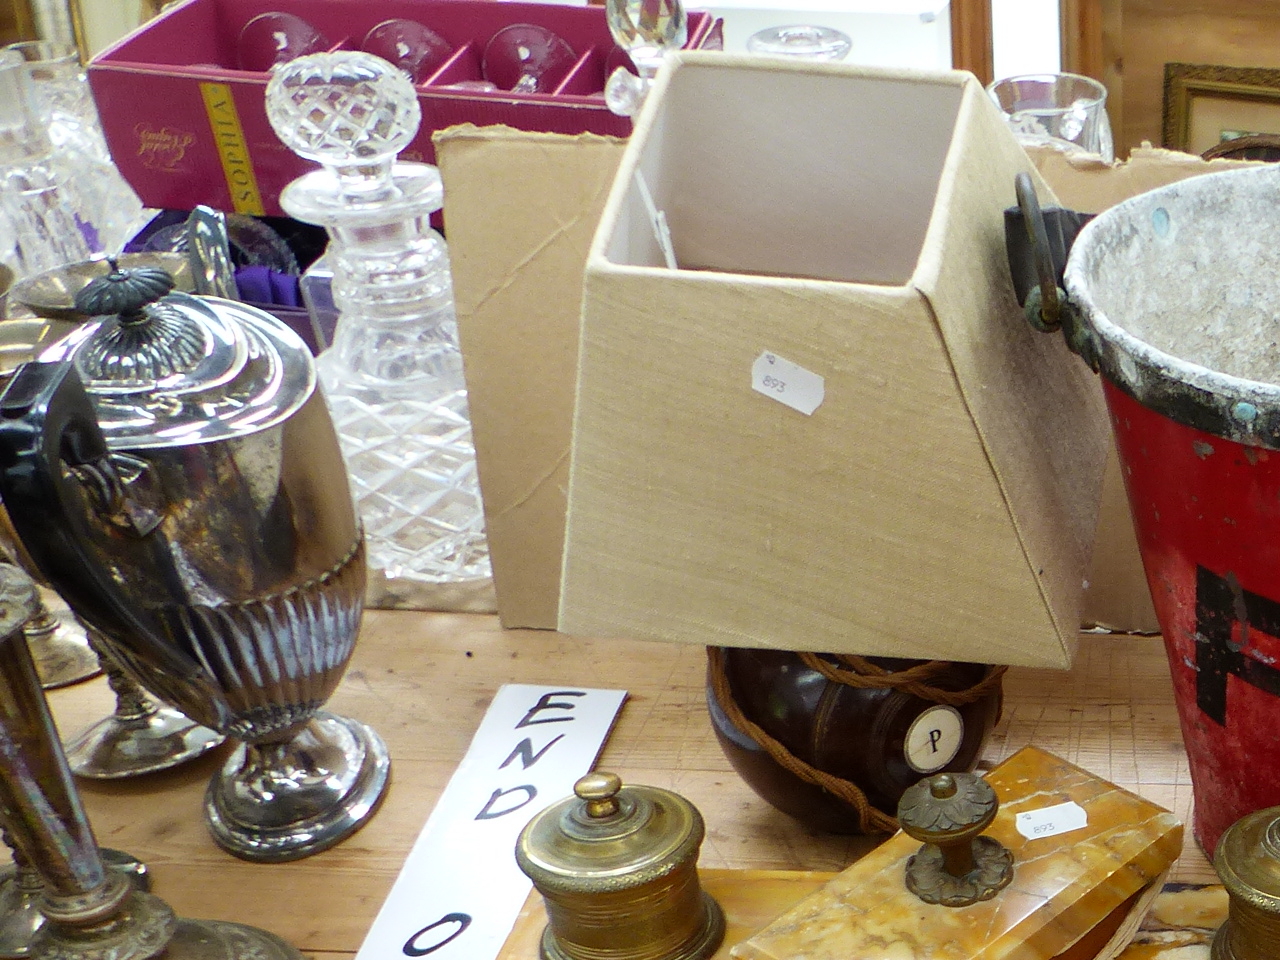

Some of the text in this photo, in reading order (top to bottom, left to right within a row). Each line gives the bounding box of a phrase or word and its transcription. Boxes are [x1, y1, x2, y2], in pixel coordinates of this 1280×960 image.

[212, 100, 254, 202] SOPHIA
[762, 374, 787, 393] 893
[929, 729, 942, 754] P
[474, 690, 588, 822] END
[1033, 822, 1055, 834] 893
